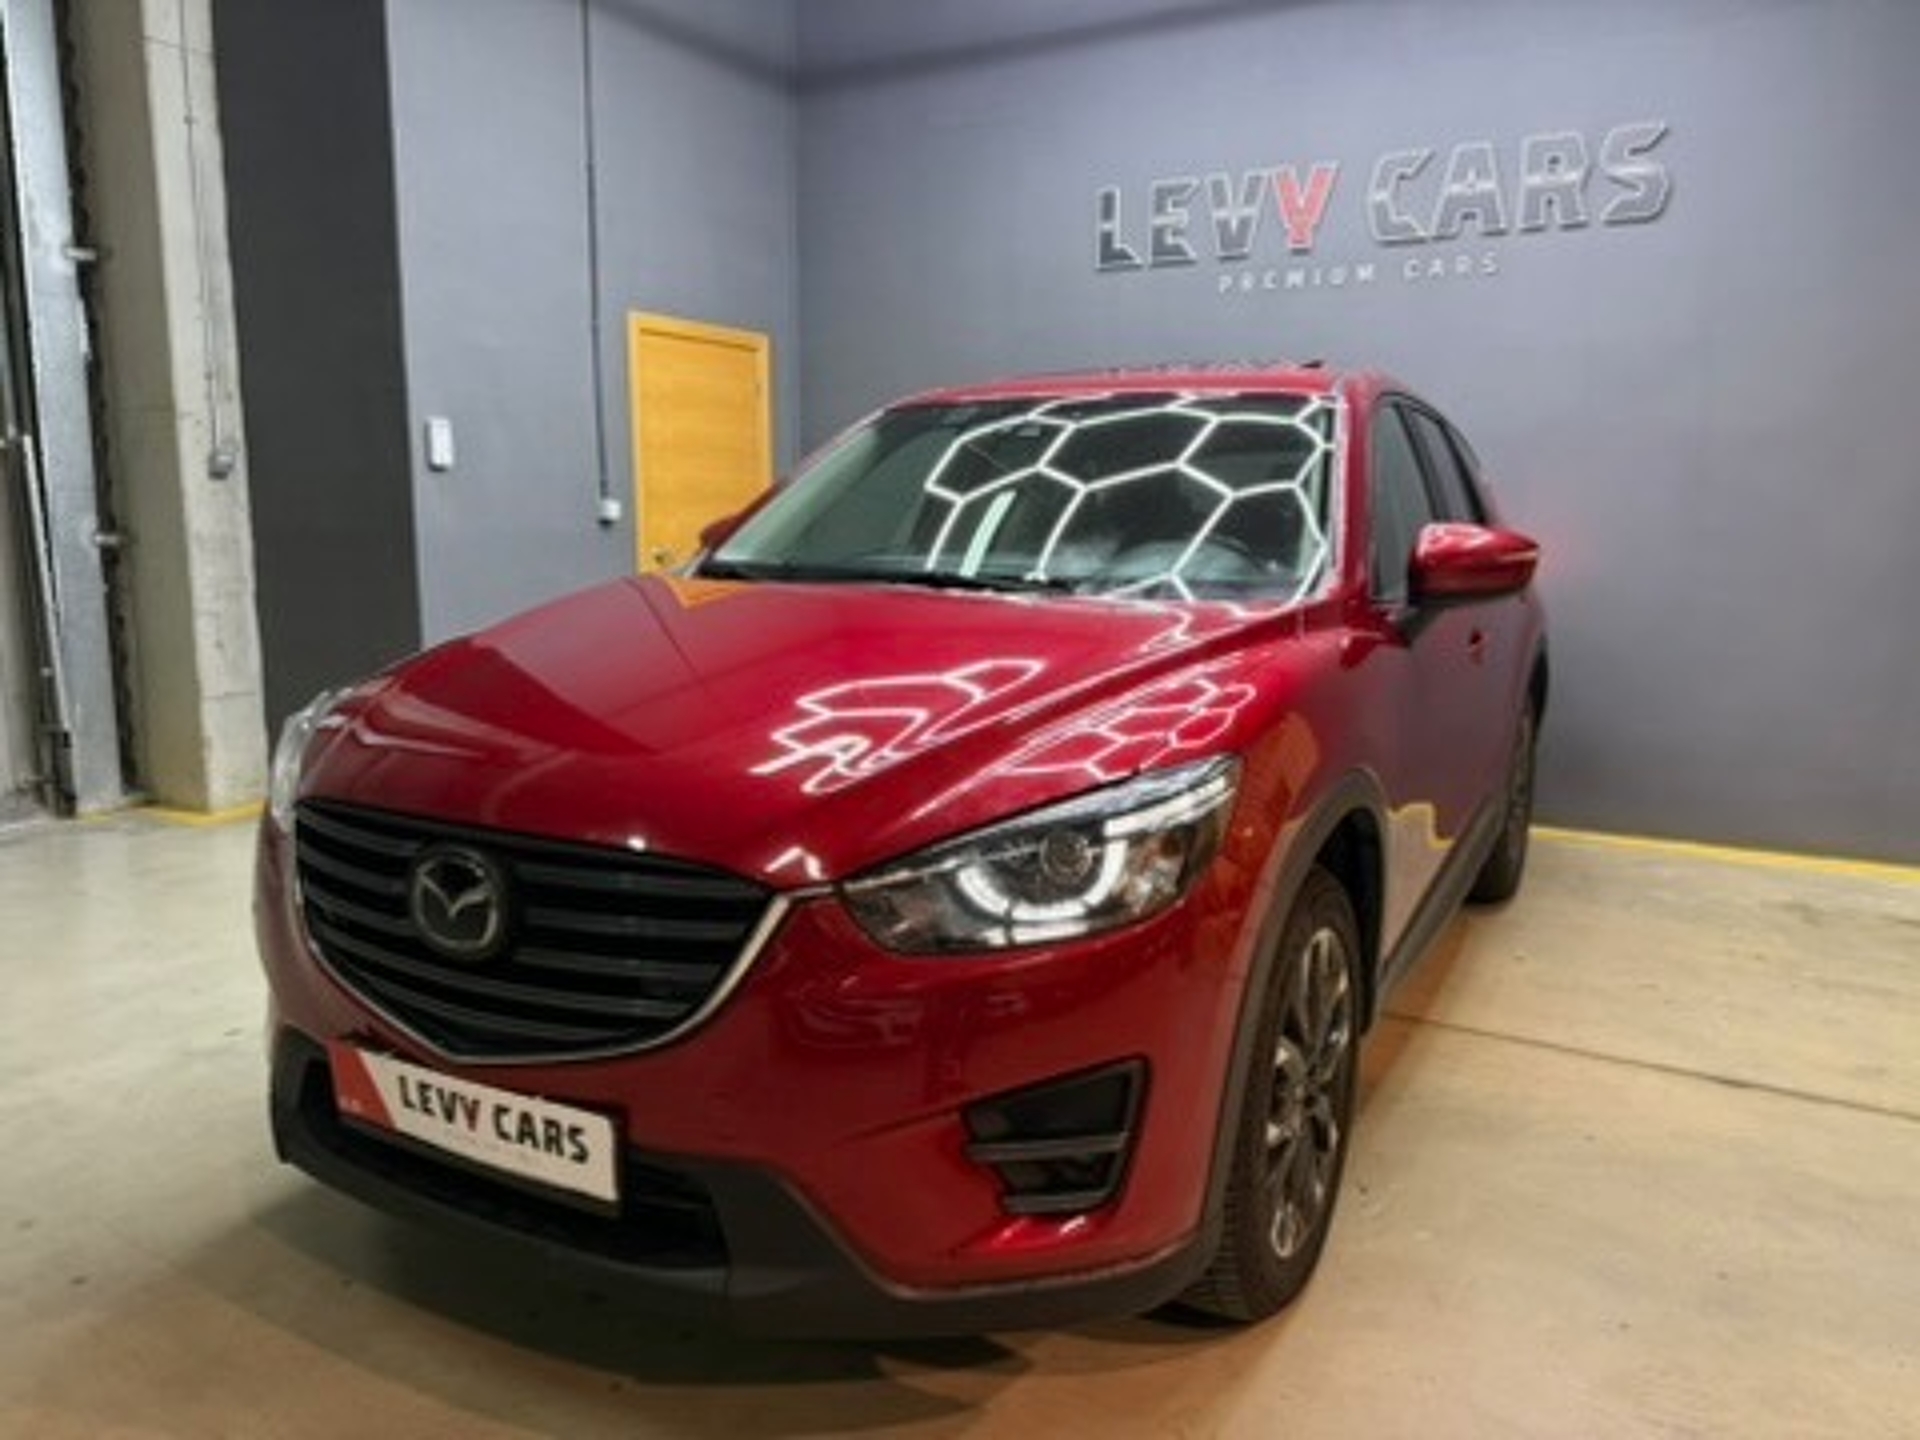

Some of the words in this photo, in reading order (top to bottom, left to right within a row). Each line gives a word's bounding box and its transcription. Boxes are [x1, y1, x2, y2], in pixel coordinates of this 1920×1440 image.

[1095, 161, 1340, 271] LEVY
[1367, 121, 1675, 245] CARS
[1218, 264, 1375, 294] PREMIUM
[1404, 252, 1500, 278] CARS
[398, 1074, 481, 1132] LEVY
[490, 1103, 590, 1164] CARS
